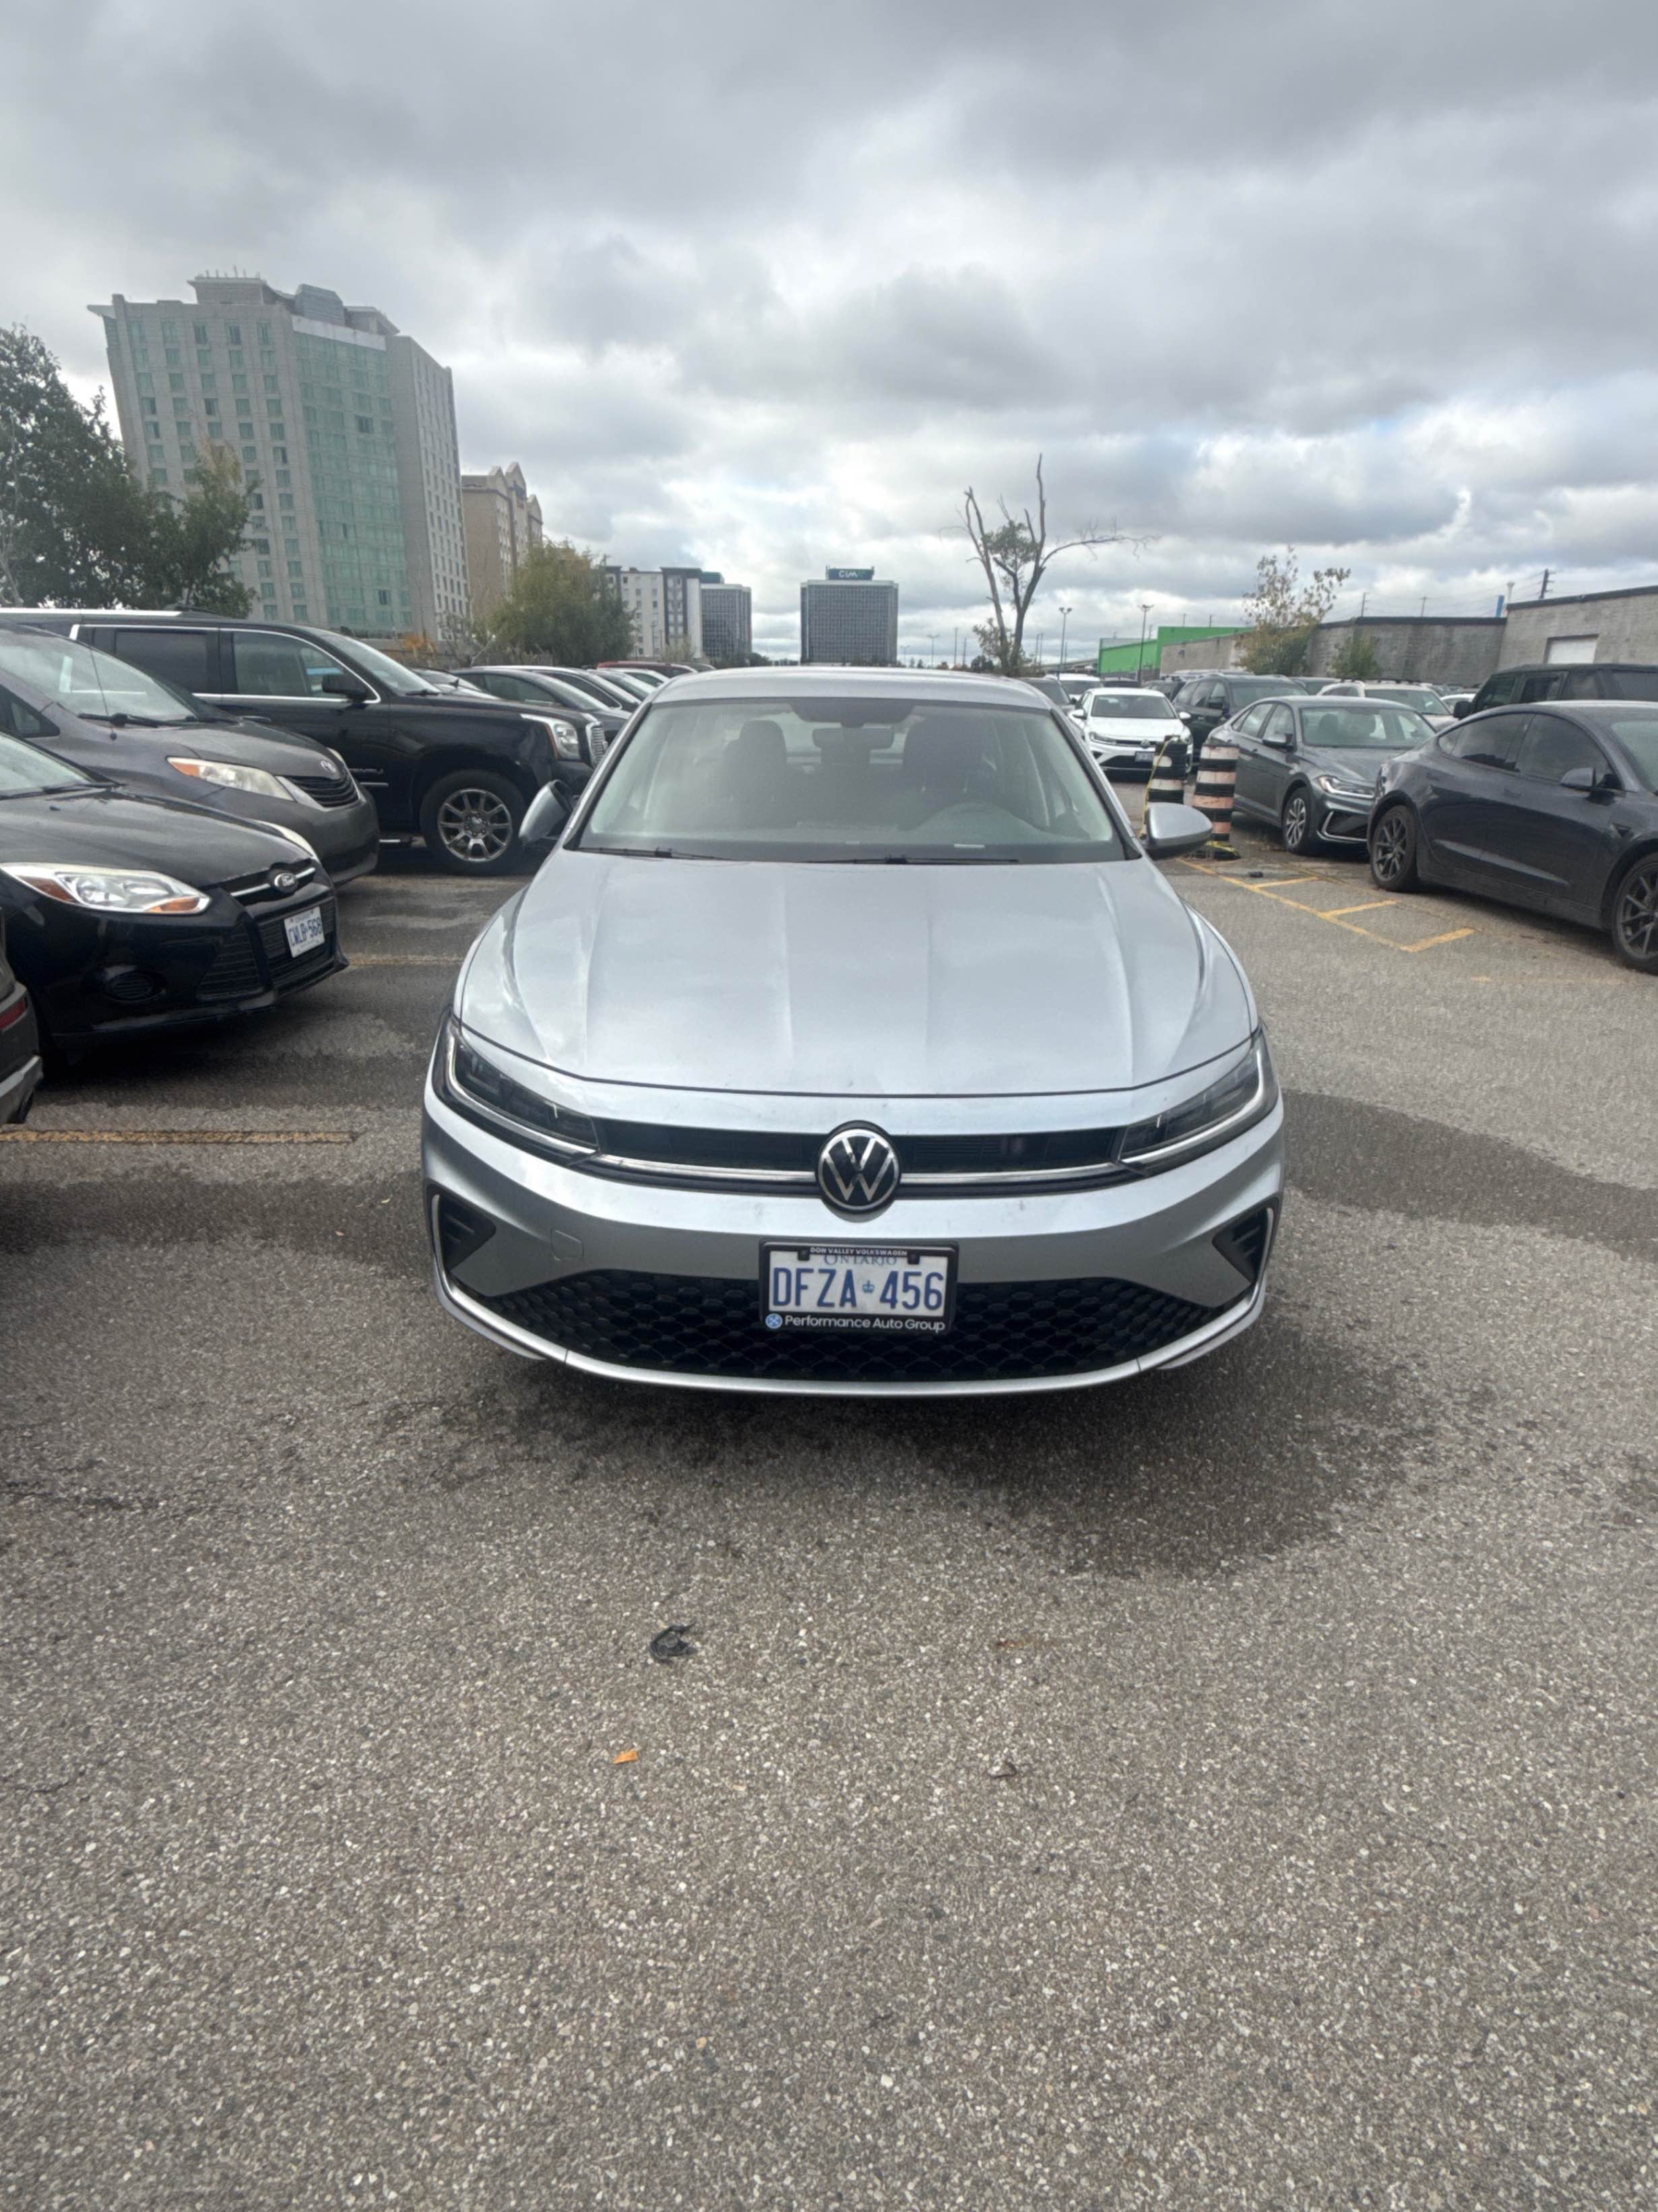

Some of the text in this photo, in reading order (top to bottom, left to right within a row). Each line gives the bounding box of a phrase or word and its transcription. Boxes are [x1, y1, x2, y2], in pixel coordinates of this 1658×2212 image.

[824, 1254, 897, 1265] ONTARIO
[773, 1267, 945, 1310] DFZA 456
[785, 1315, 945, 1333] Performance Auto Group
